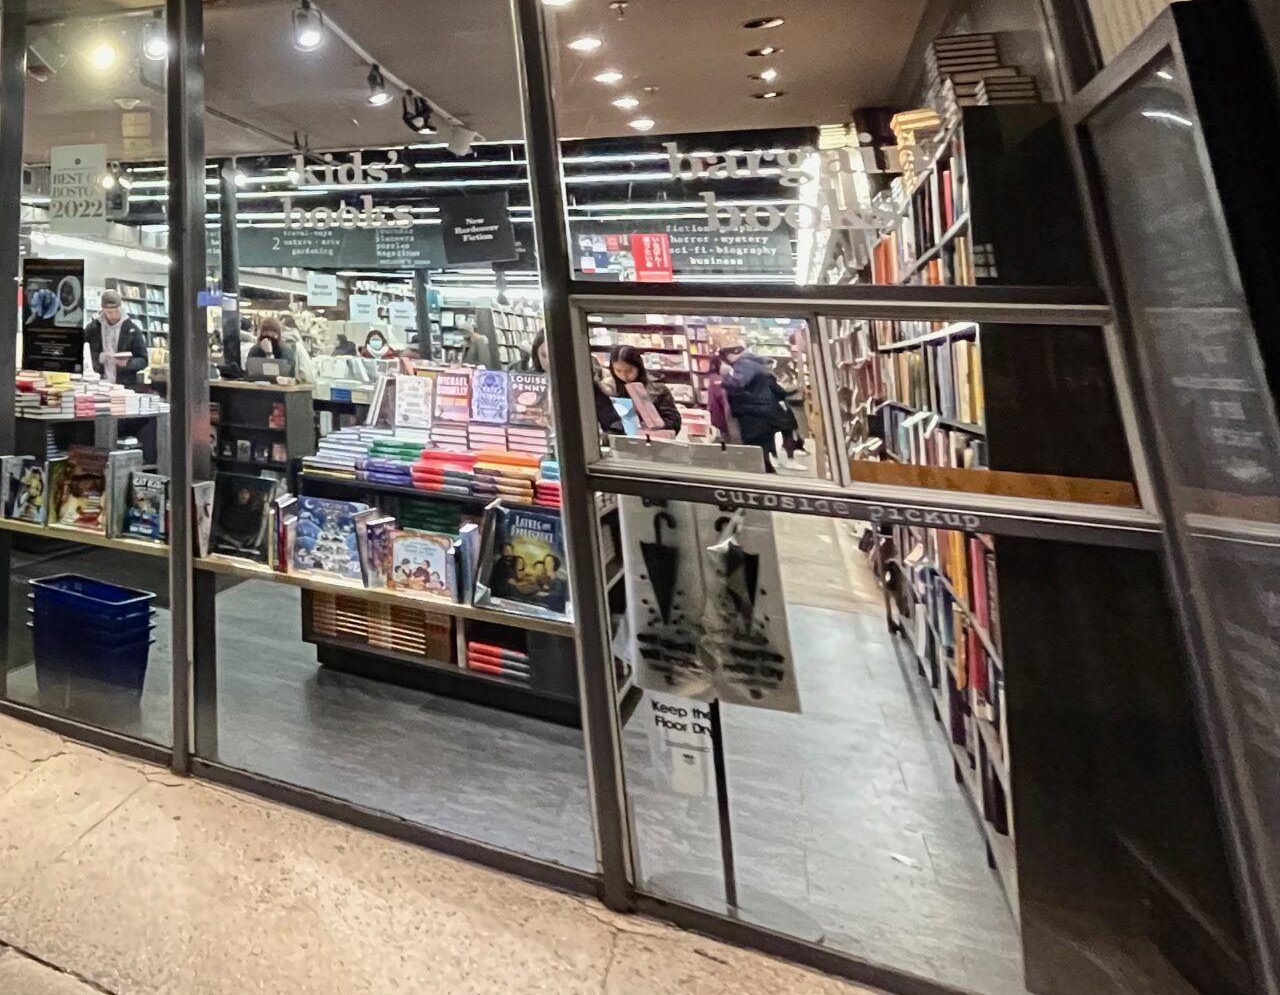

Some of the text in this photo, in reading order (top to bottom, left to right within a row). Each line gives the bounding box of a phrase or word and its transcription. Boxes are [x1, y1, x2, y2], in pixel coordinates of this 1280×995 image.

[53, 172, 84, 184] BEST
[53, 186, 101, 198] BOSTO
[52, 199, 103, 218] 2022
[280, 194, 415, 229] books
[462, 233, 494, 242] Fiction
[670, 234, 768, 244] horror mystery
[272, 237, 281, 251] 2
[716, 245, 777, 255] biography
[689, 256, 744, 265] business
[511, 375, 548, 385] LOUISE
[512, 384, 547, 393] PENNY
[714, 489, 981, 531] curbside pickup
[651, 699, 688, 718] Keep
[655, 715, 688, 732] Floor
